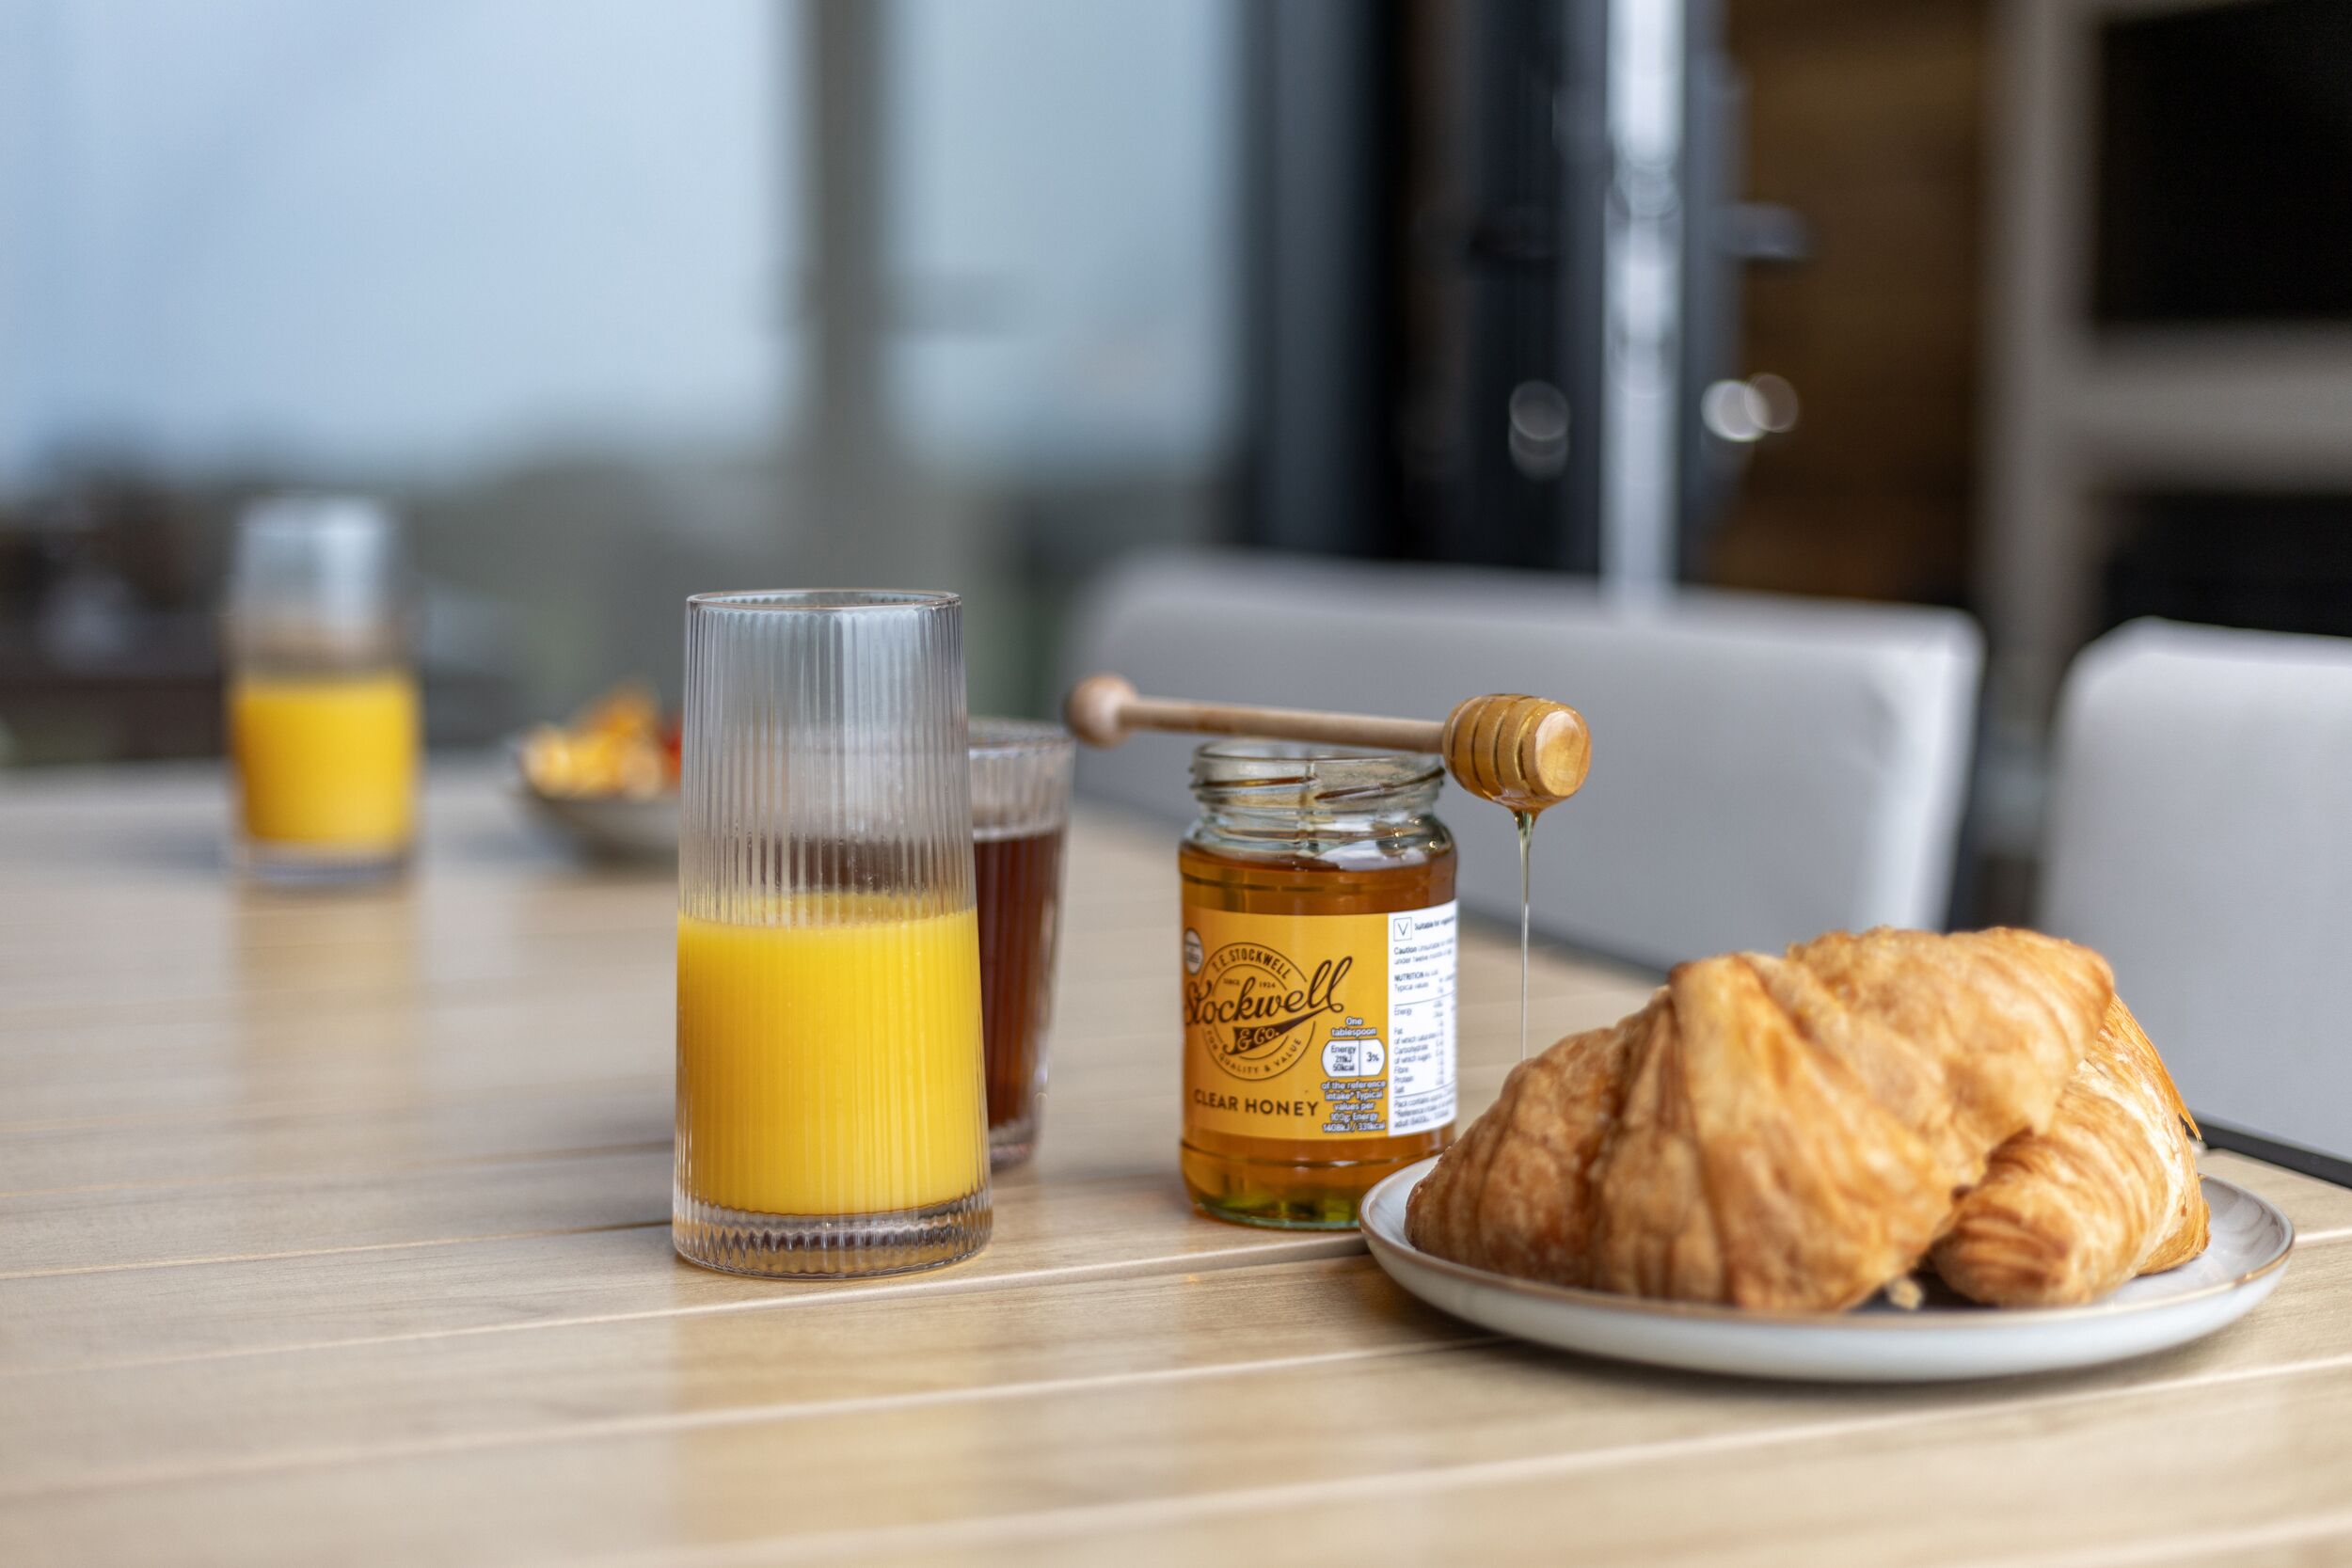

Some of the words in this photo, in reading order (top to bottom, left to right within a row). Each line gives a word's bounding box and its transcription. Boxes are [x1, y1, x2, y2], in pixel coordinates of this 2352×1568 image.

[1394, 946, 1417, 955] Caution
[1185, 956, 1353, 1026] Stockwell
[1345, 1017, 1363, 1026] One
[1331, 1026, 1377, 1038] tablespoon
[1274, 1037, 1302, 1066] VALUE
[1330, 1044, 1357, 1054] Energy
[1366, 1052, 1379, 1062] 3%
[1321, 1082, 1330, 1090] of
[1331, 1081, 1345, 1090] the
[1347, 1080, 1387, 1089] reference
[1356, 1090, 1383, 1101] Typical
[1194, 1089, 1238, 1111] CLEAR
[1245, 1098, 1319, 1117] HONEY
[1333, 1102, 1359, 1111] values
[1360, 1102, 1375, 1113] per
[1352, 1111, 1379, 1122] Energy
